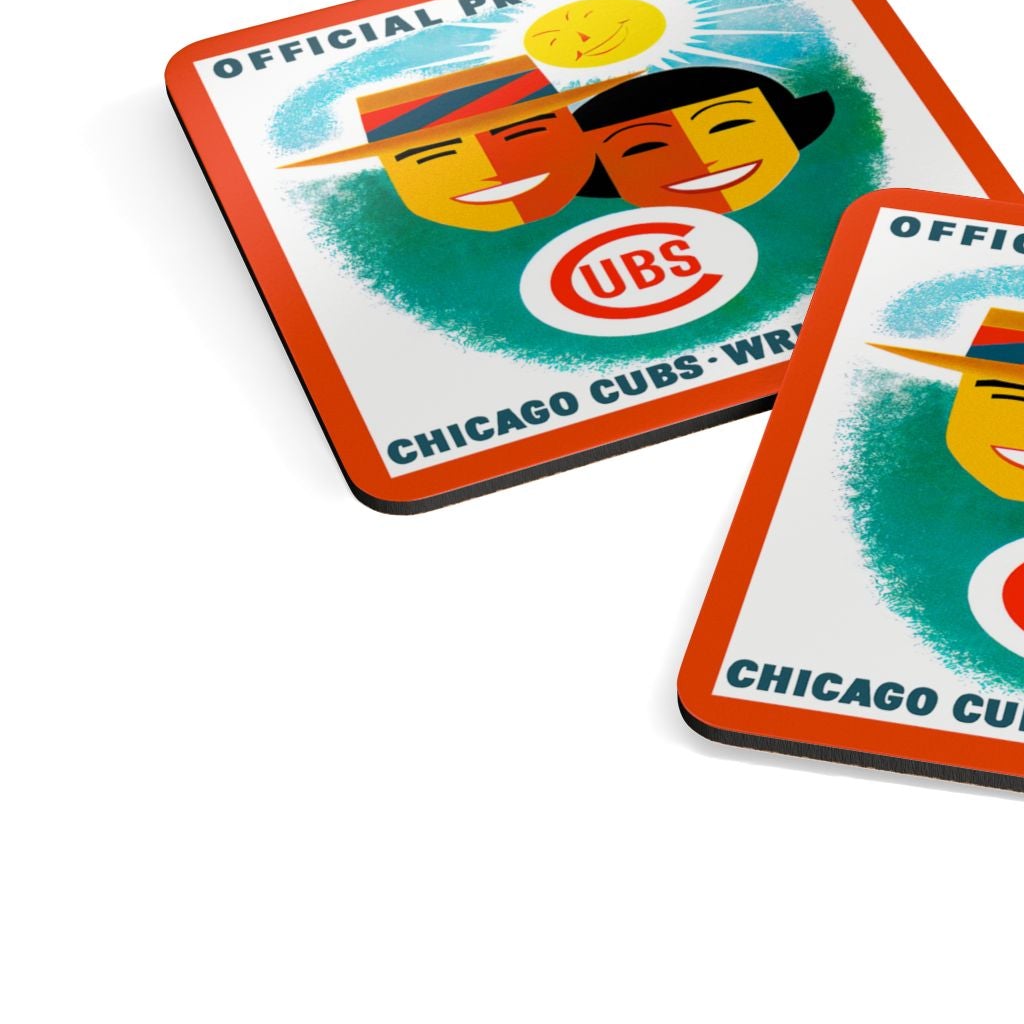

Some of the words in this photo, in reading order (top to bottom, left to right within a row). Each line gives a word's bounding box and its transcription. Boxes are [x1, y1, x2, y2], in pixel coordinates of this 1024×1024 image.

[212, 8, 443, 79] OFFICIAL
[386, 391, 579, 465] CHICAGO
[589, 354, 704, 405] CUBS
[725, 658, 939, 717] CHICAGO
